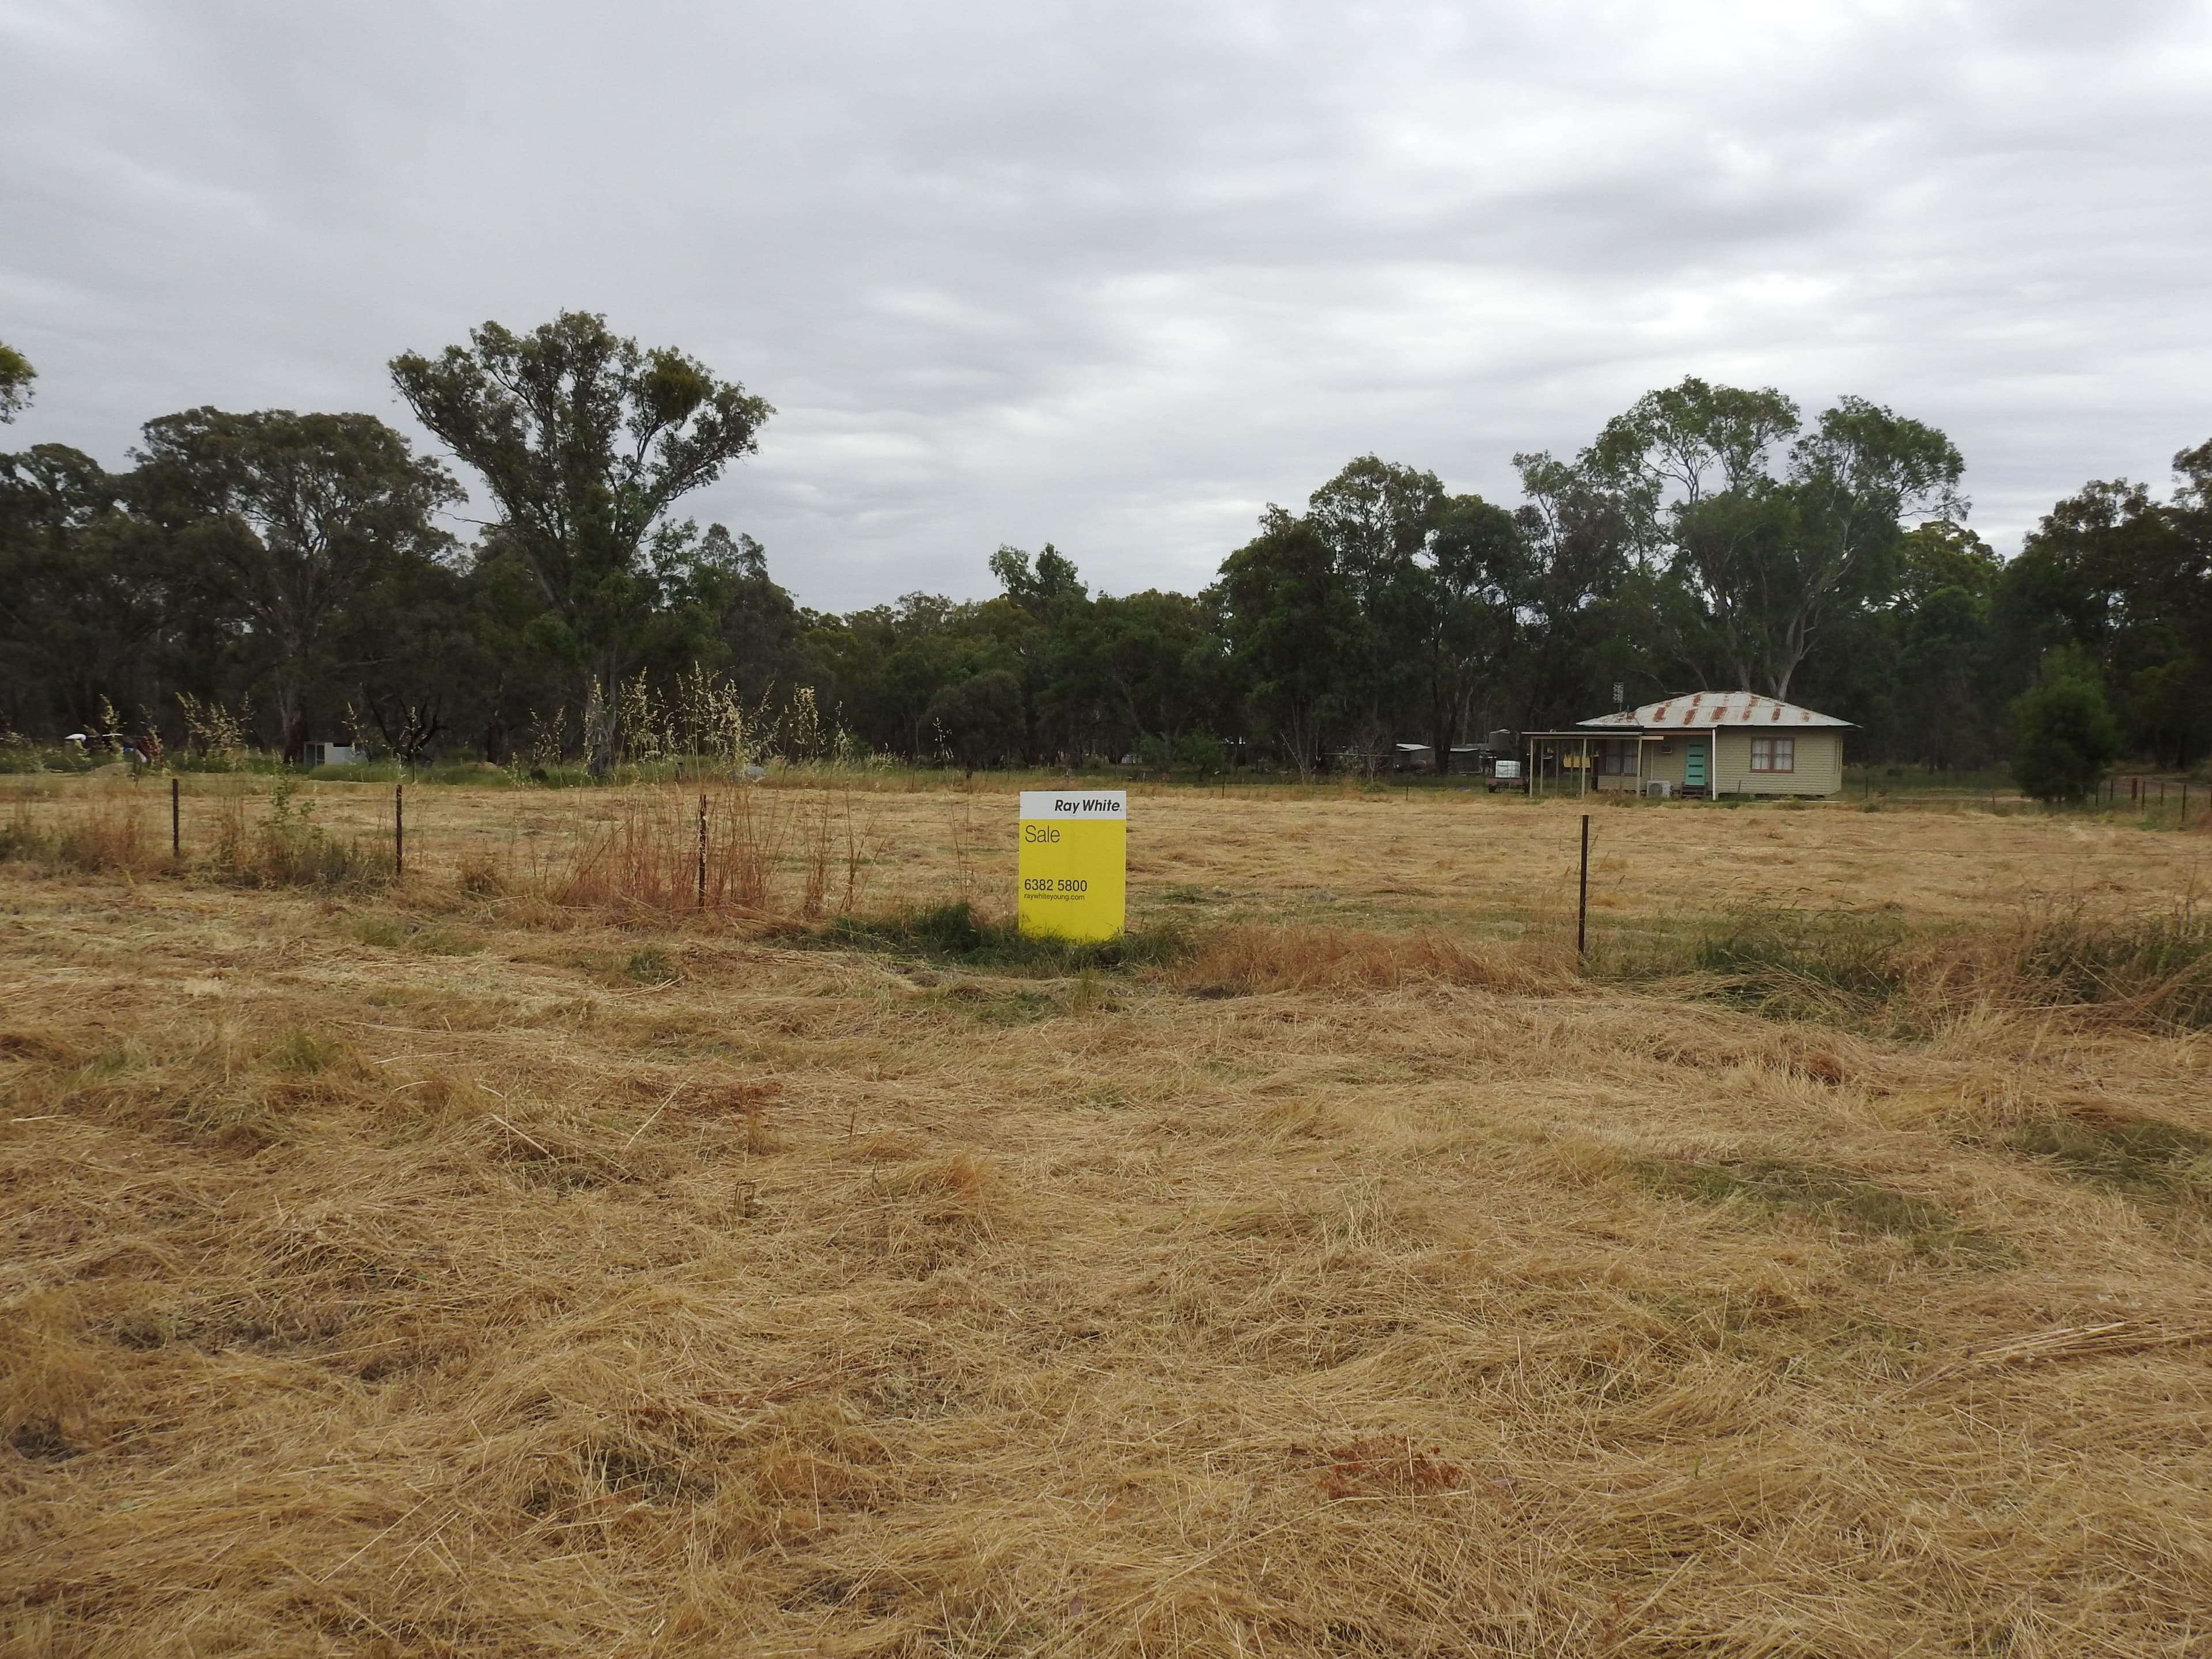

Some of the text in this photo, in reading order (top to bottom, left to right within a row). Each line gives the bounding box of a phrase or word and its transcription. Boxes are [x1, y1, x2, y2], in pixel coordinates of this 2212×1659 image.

[1055, 800, 1120, 814] Ray White
[1025, 825, 1060, 843] Sale
[1025, 879, 1087, 892] 6382 5800
